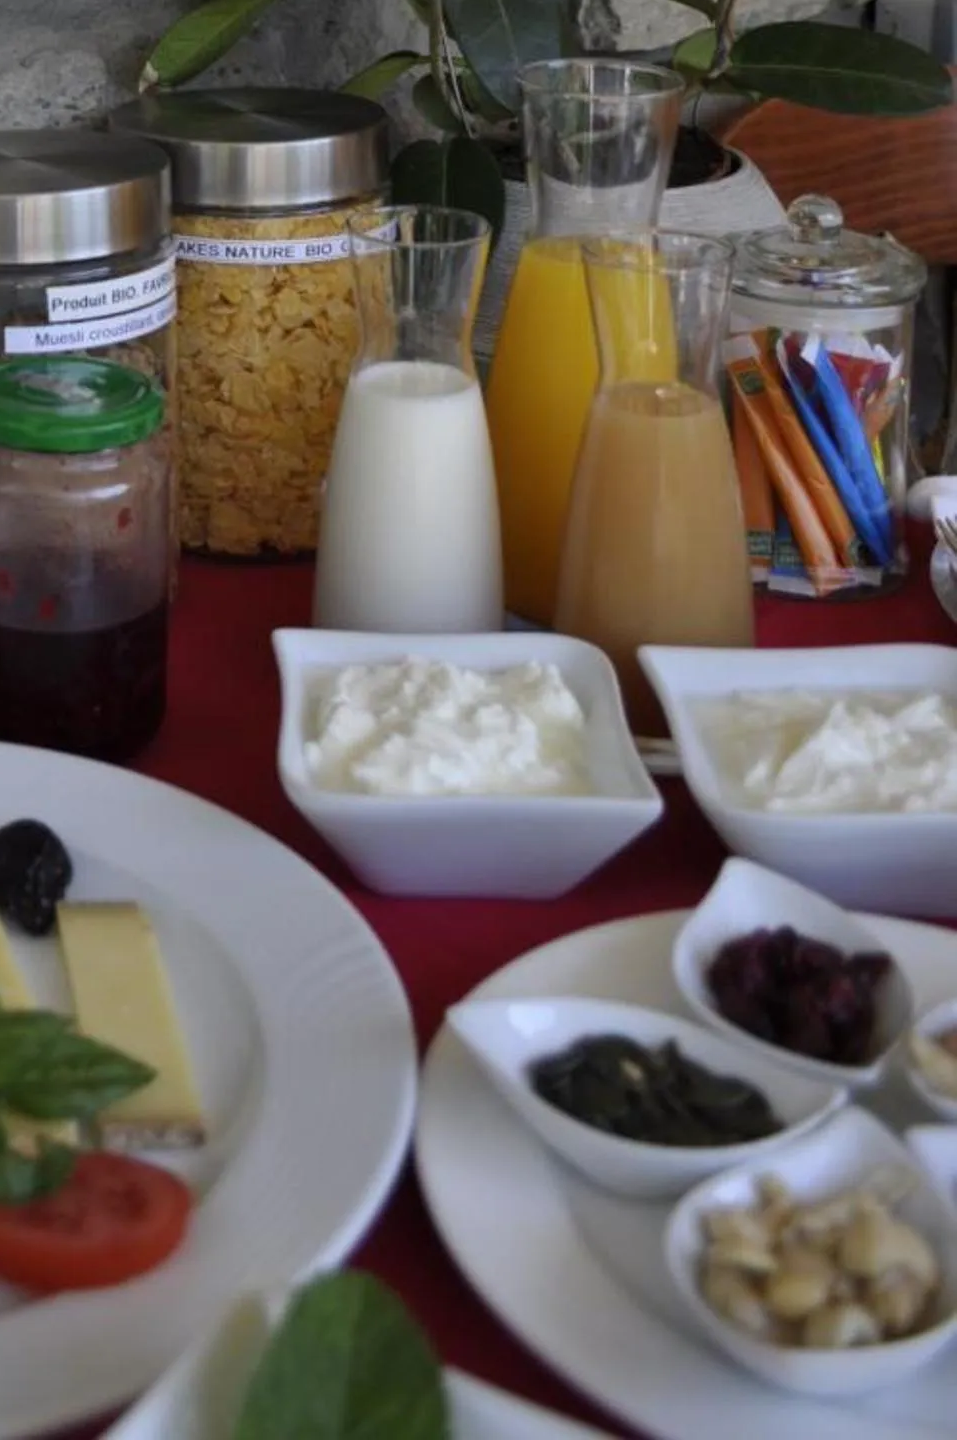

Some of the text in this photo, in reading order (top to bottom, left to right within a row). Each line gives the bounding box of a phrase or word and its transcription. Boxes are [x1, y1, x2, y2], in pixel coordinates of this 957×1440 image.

[176, 240, 333, 259] AKES NATURE BIO
[51, 292, 108, 312] Produit
[34, 327, 84, 346] Muesli
